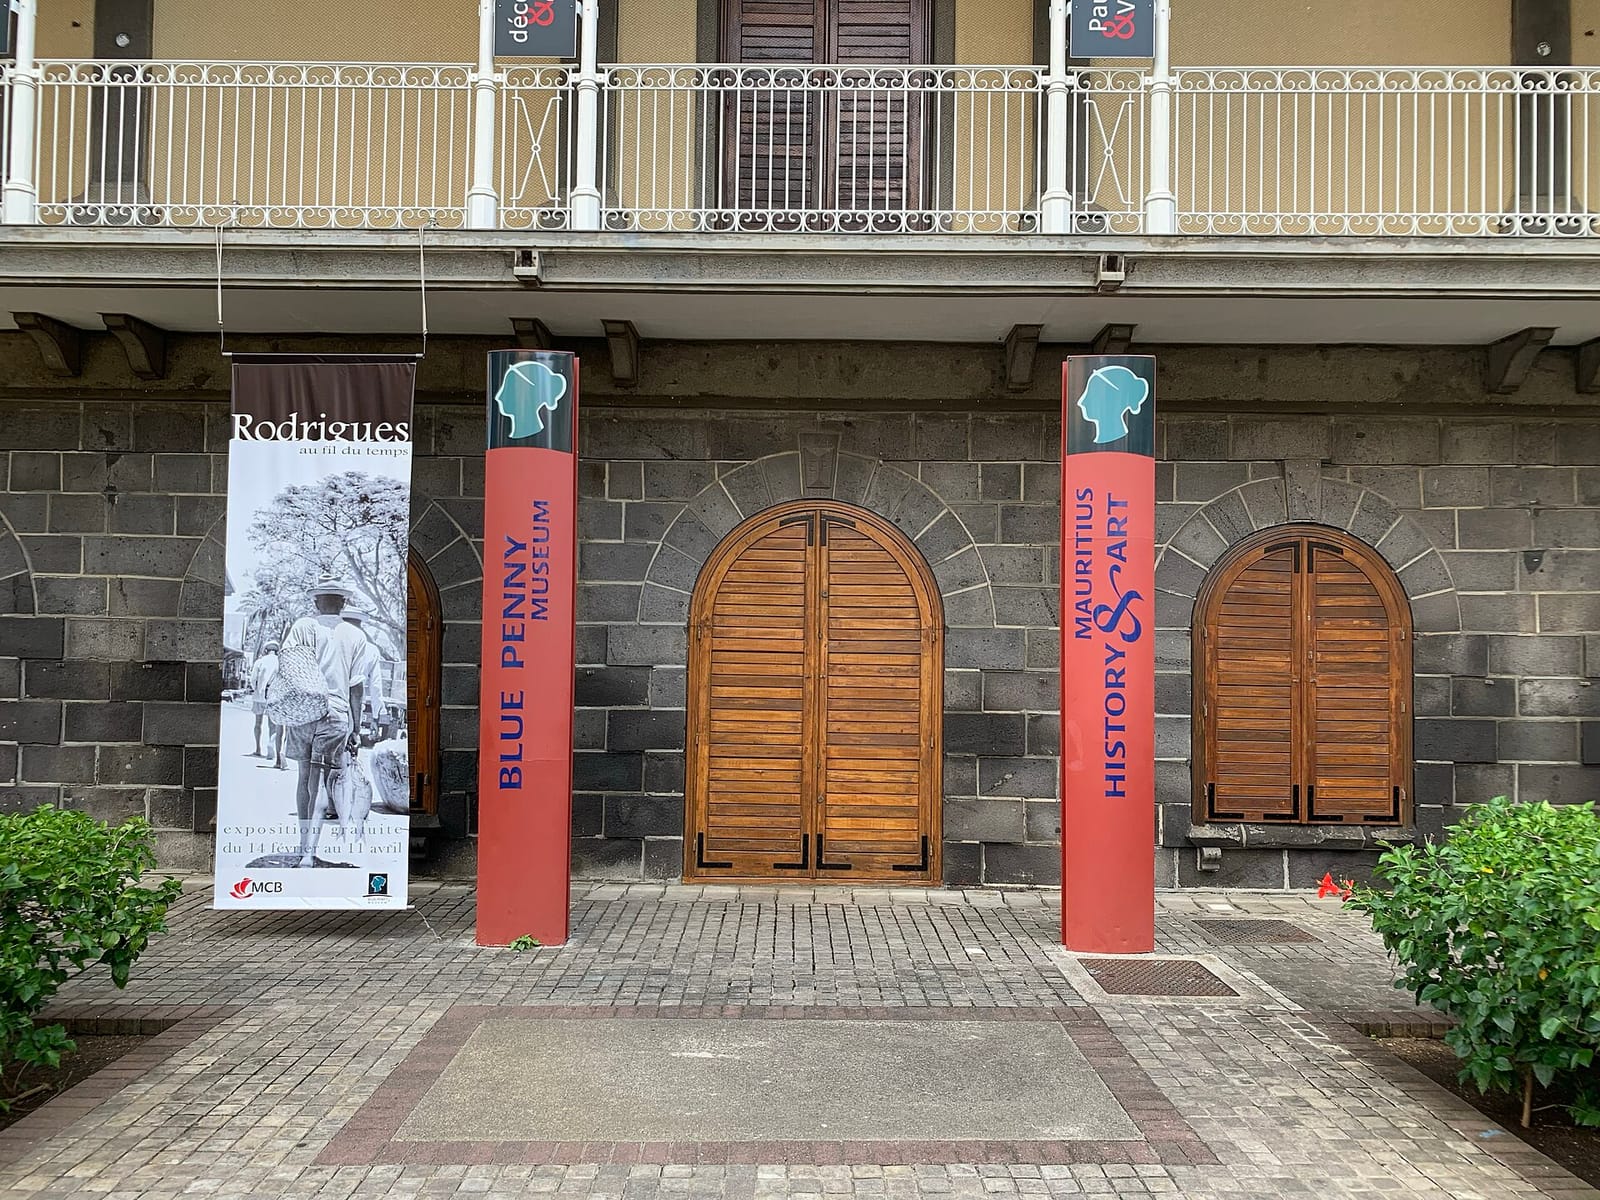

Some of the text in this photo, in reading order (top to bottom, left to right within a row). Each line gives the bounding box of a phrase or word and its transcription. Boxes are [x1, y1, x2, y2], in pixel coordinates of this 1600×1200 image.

[507, 0, 528, 43] déc
[1088, 0, 1108, 31] Pa
[1101, 11, 1135, 39] &
[231, 412, 409, 442] Rodrigues
[299, 445, 409, 458] au fil du temps
[531, 499, 550, 621] MUSEUM
[1074, 487, 1093, 640] MAURITIUS
[1092, 492, 1145, 799] HISTORY & ART
[499, 535, 527, 790] BLUE PENNY
[223, 823, 402, 838] exposition gratuite
[222, 841, 402, 854] du 14 février au 11 avril
[251, 881, 283, 893] MCB
